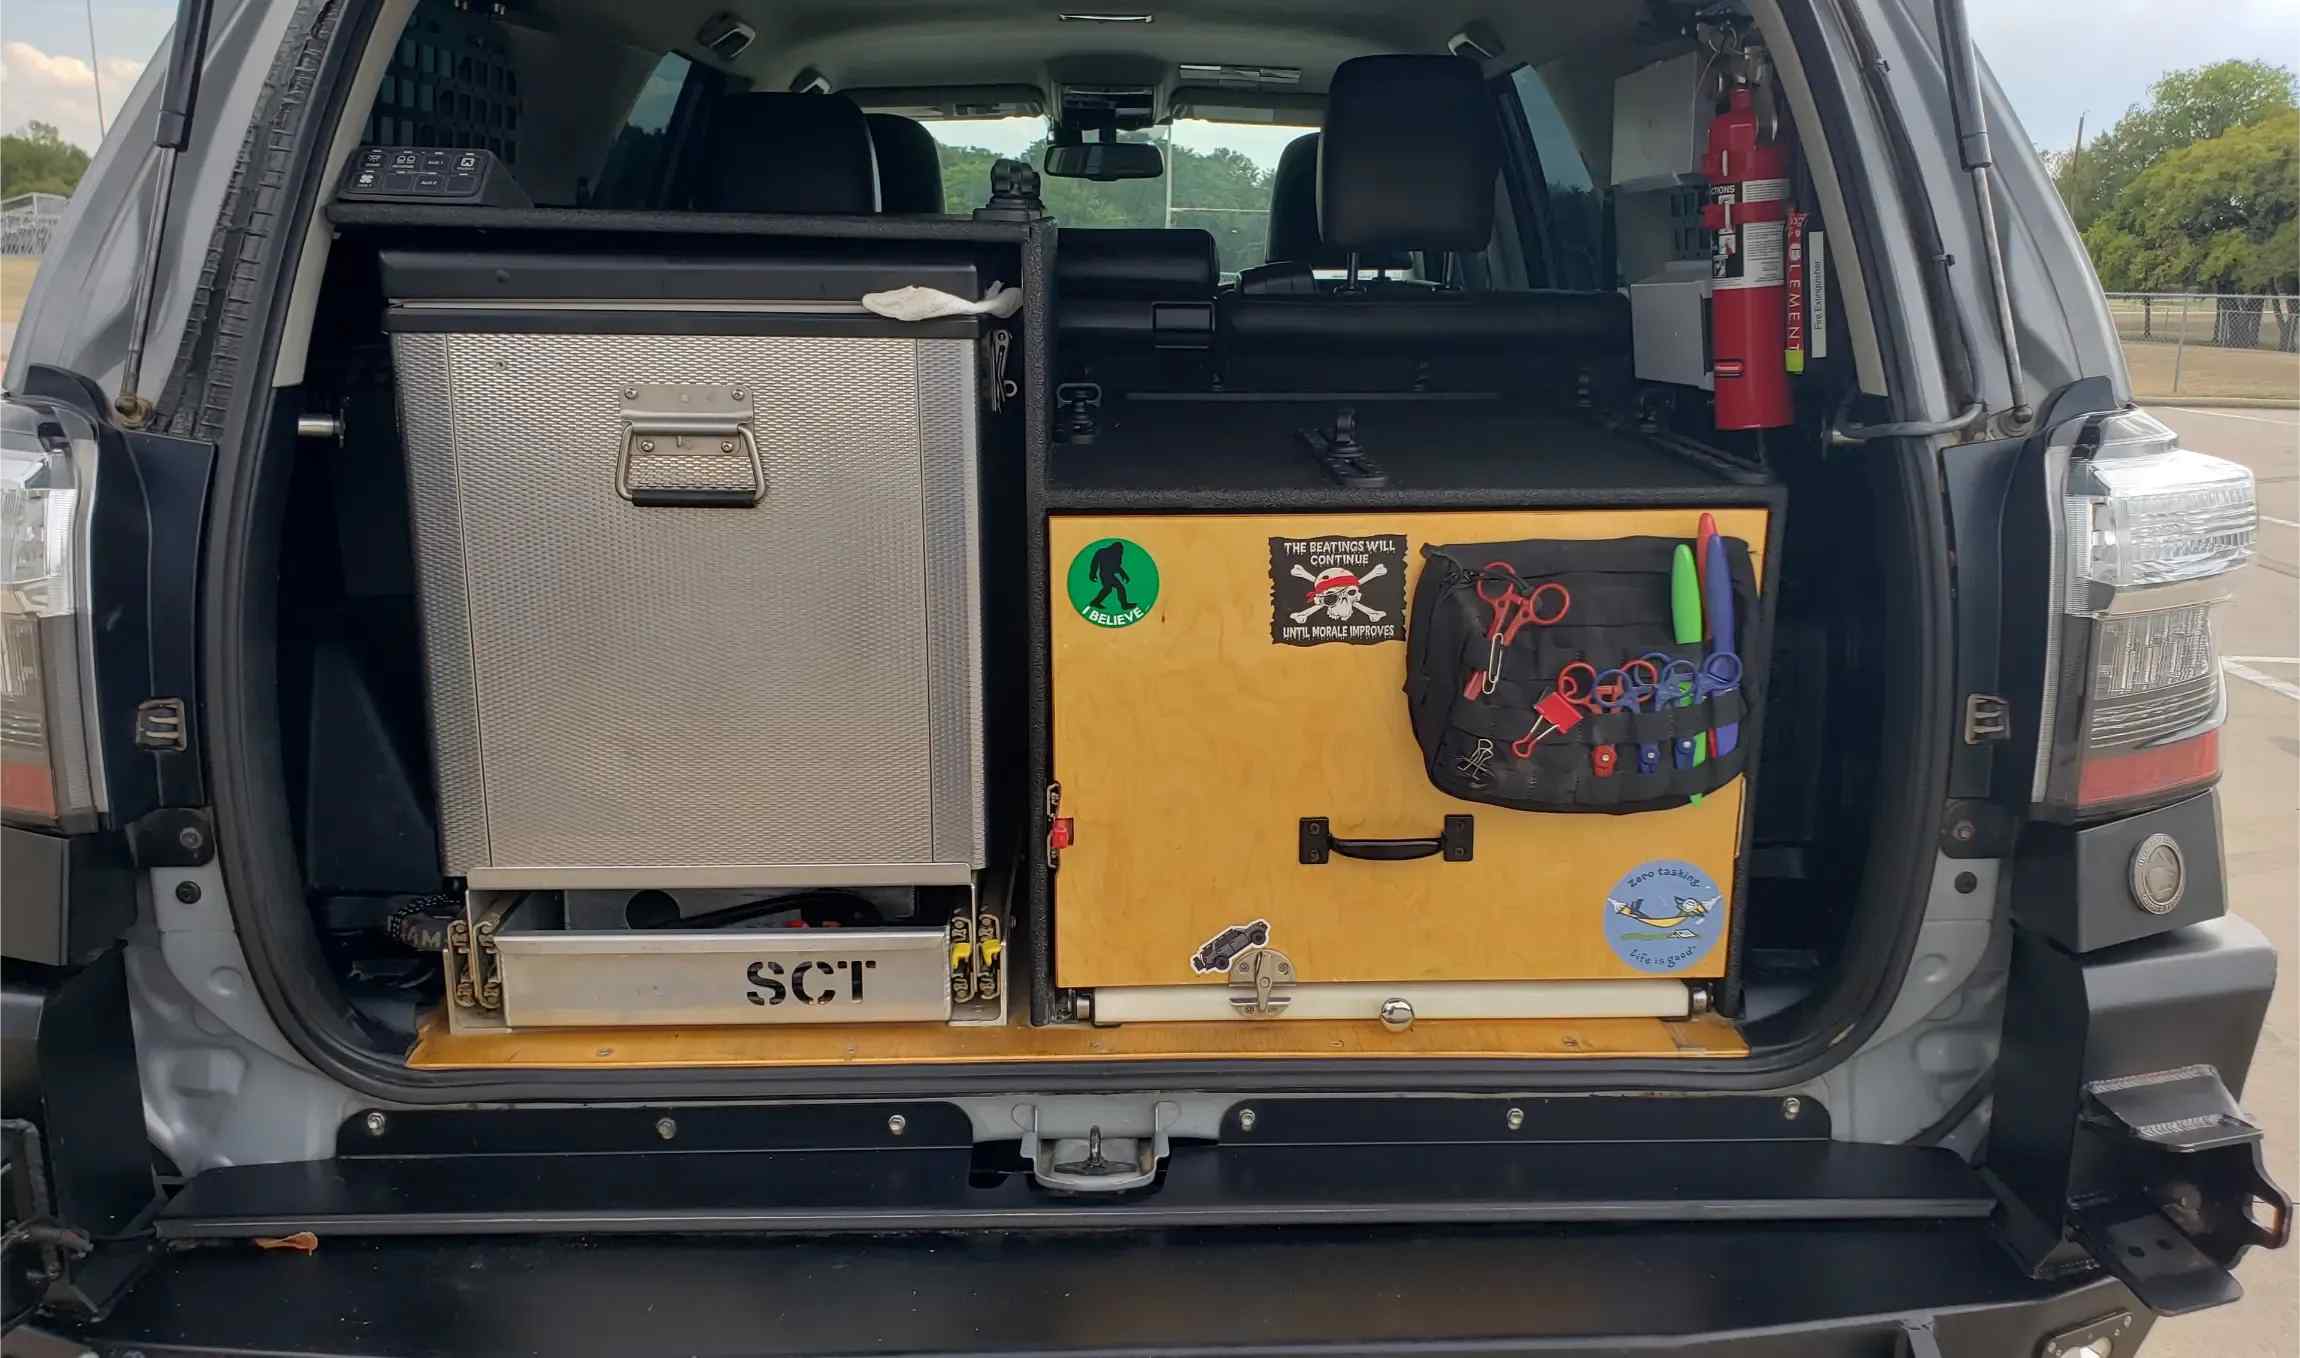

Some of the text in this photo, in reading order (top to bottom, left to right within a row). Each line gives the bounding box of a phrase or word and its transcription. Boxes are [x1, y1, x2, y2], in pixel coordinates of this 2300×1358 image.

[1814, 261, 1823, 330] Fire Extinguisher
[1284, 539, 1396, 554] THE BEATINGS WILL
[1310, 553, 1369, 566] CONTINUE
[1082, 606, 1144, 625] I BELIEVE
[1283, 624, 1395, 640] UNTIL MORALE IMPROVES
[1654, 957, 1665, 965] is
[746, 960, 876, 1006] SCT
